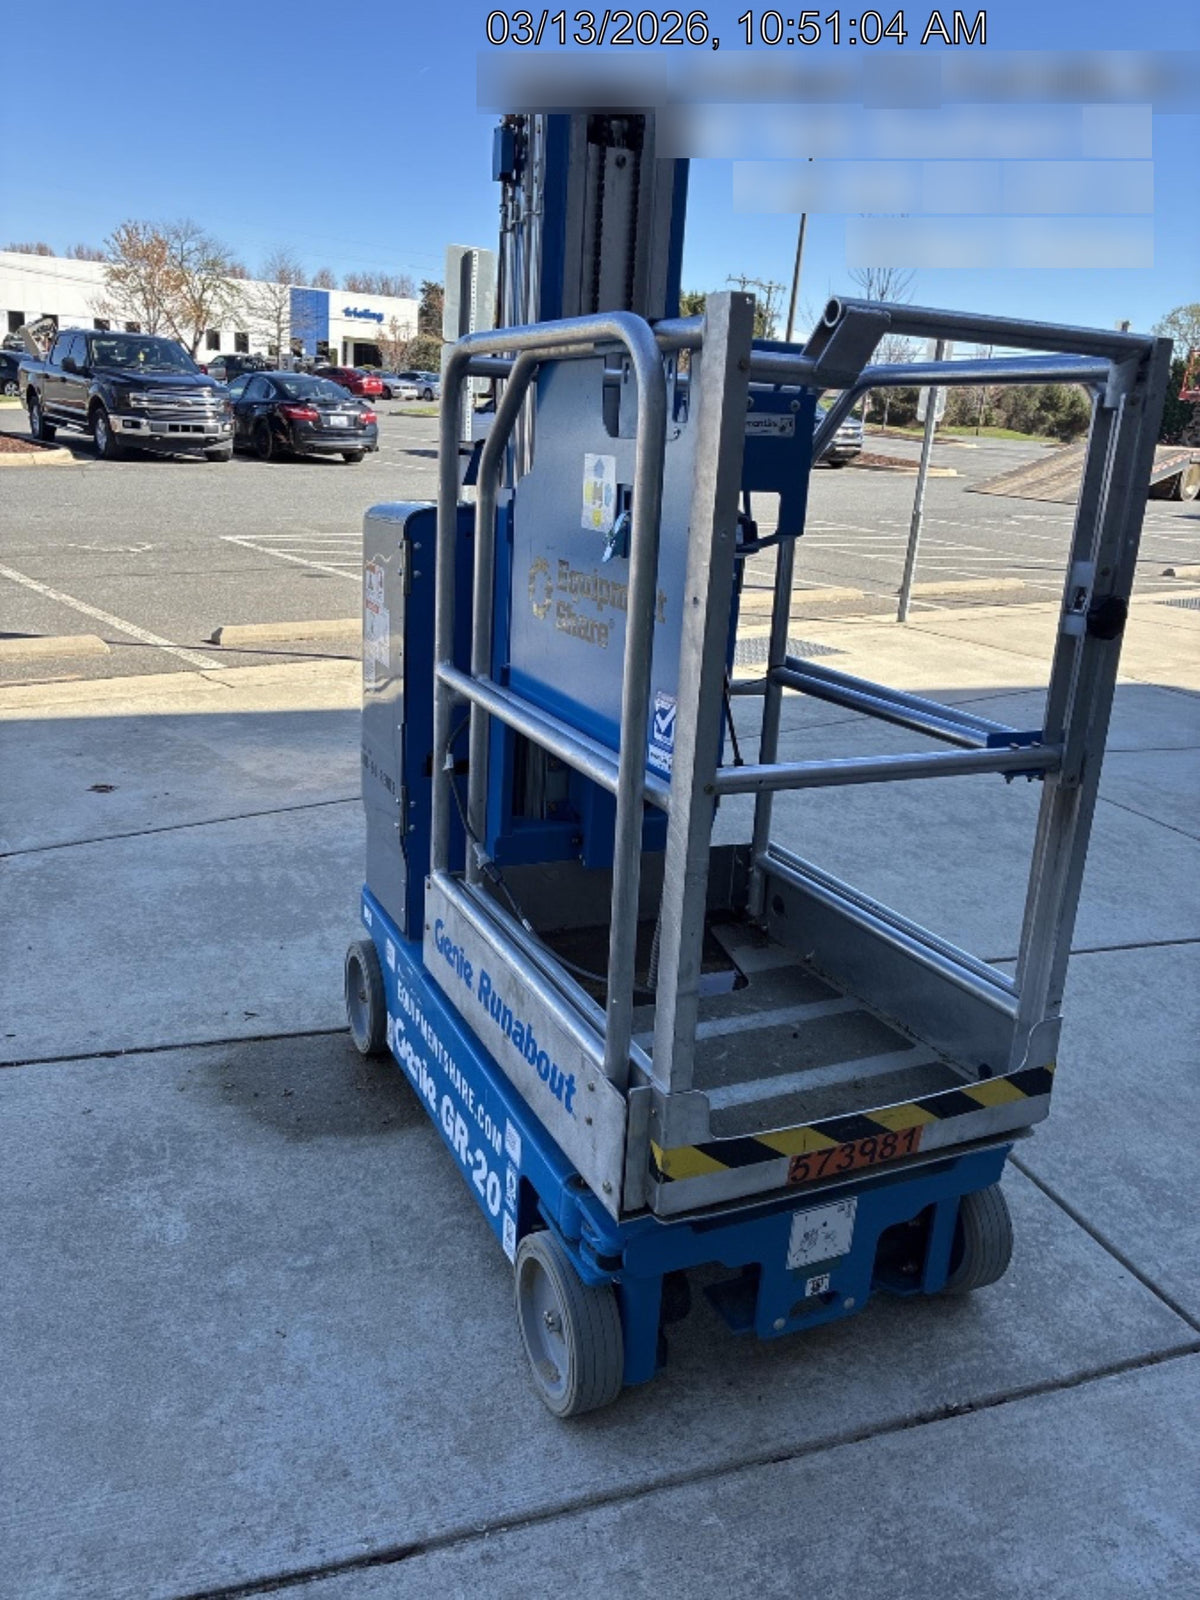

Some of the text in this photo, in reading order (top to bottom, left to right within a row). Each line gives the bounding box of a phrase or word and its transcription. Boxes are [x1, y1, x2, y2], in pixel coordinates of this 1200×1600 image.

[557, 559, 667, 625] Equipmt
[434, 918, 577, 1115] Genie Runabout
[395, 1017, 437, 1113] Genie
[441, 1094, 501, 1218] GR-20
[789, 1127, 918, 1182] 573981
